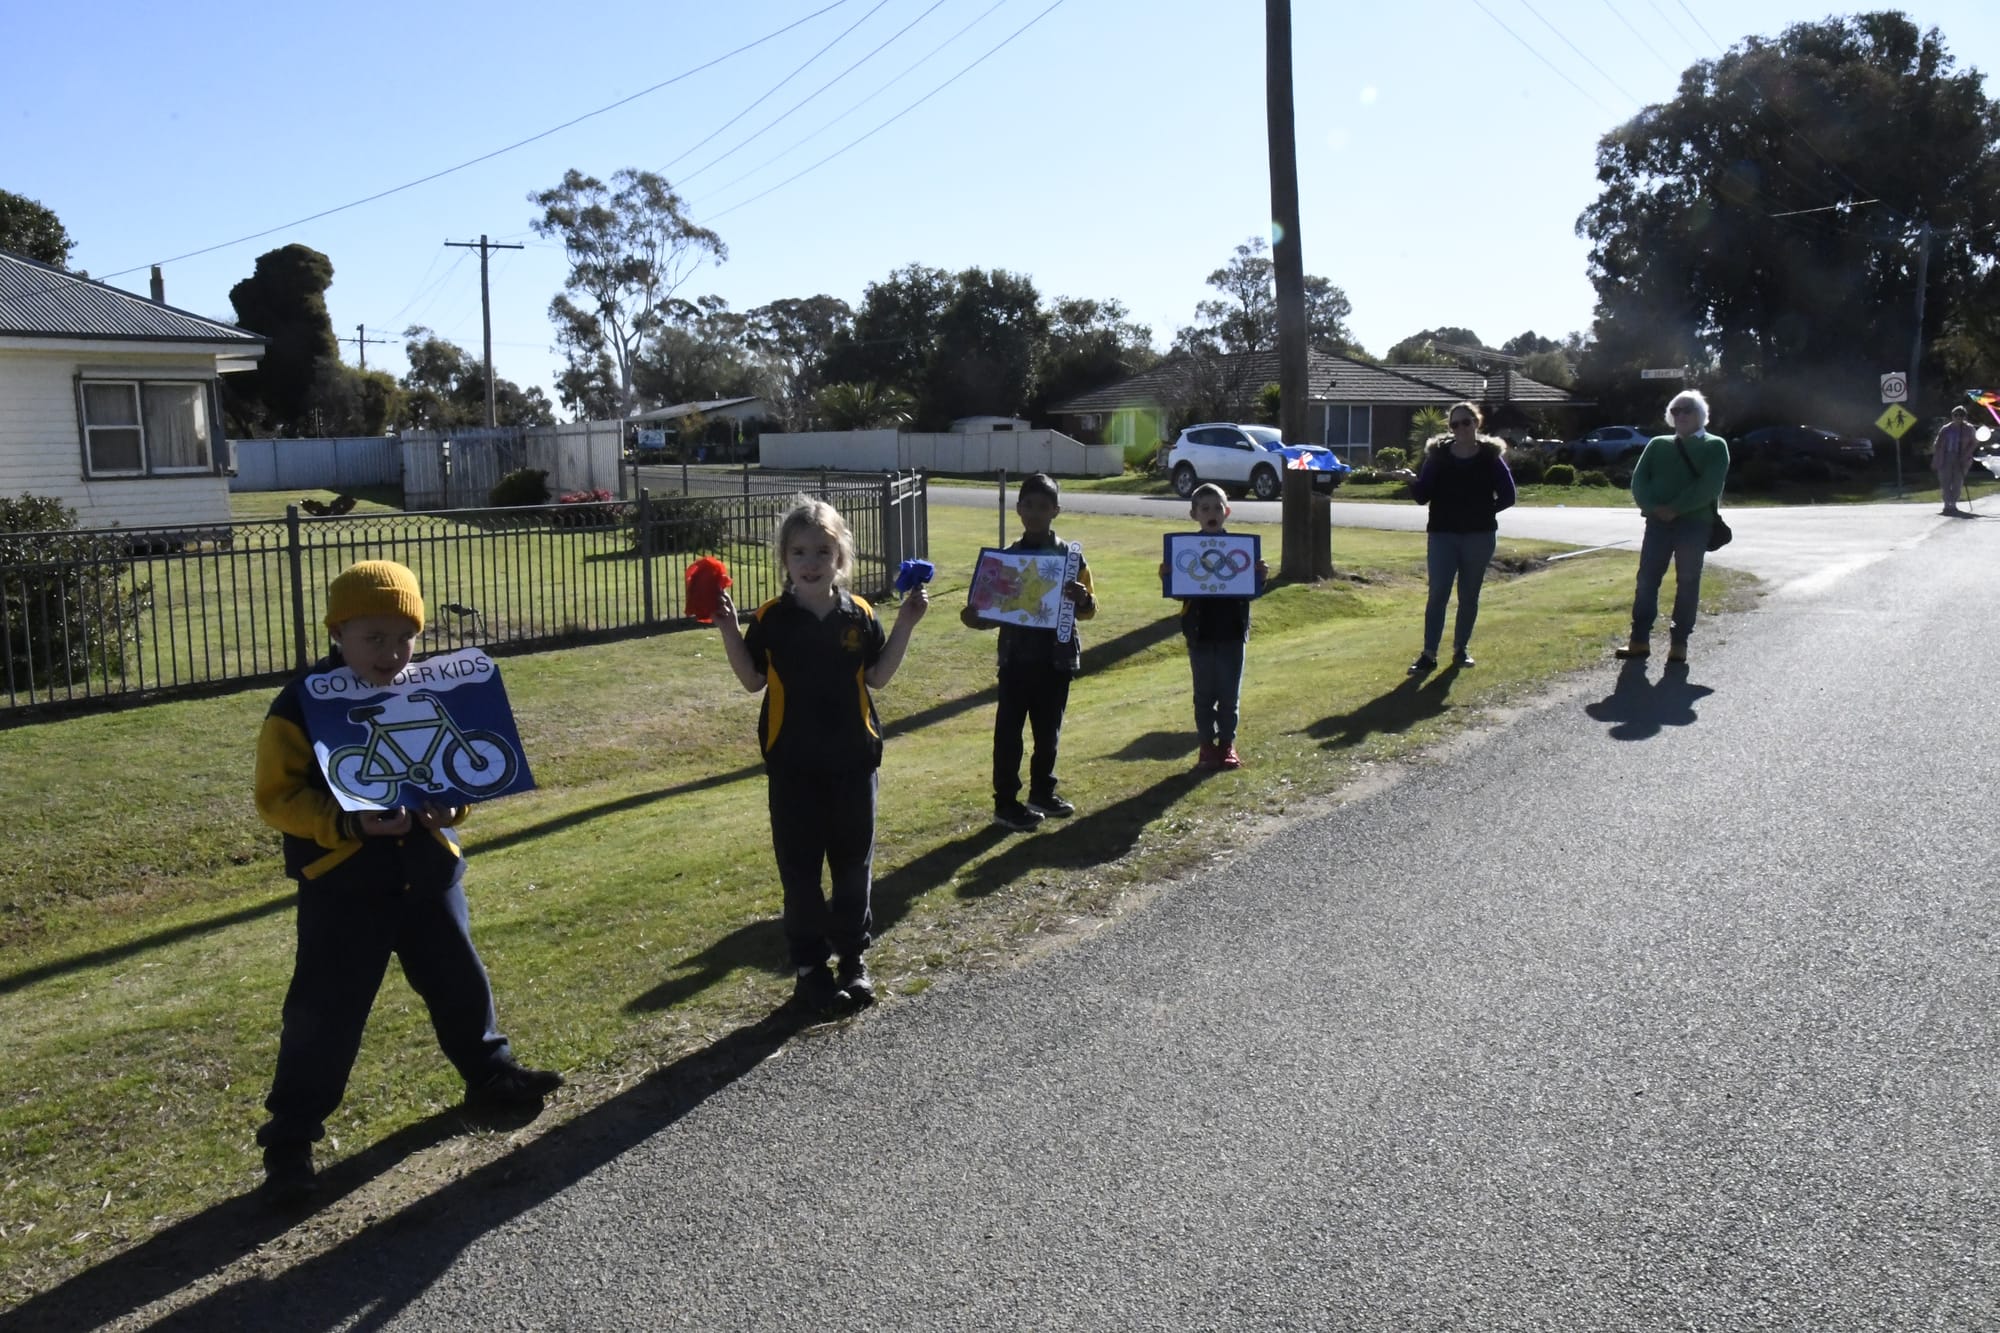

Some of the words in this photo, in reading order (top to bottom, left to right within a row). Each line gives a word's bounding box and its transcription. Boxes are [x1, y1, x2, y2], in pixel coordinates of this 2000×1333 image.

[1885, 381, 1902, 392] 40
[1070, 542, 1081, 561] GO
[1062, 564, 1077, 610] KINR
[1059, 613, 1072, 641] KIDS
[311, 675, 348, 695] GO
[352, 666, 436, 690] KDER
[438, 656, 490, 680] KIDS
